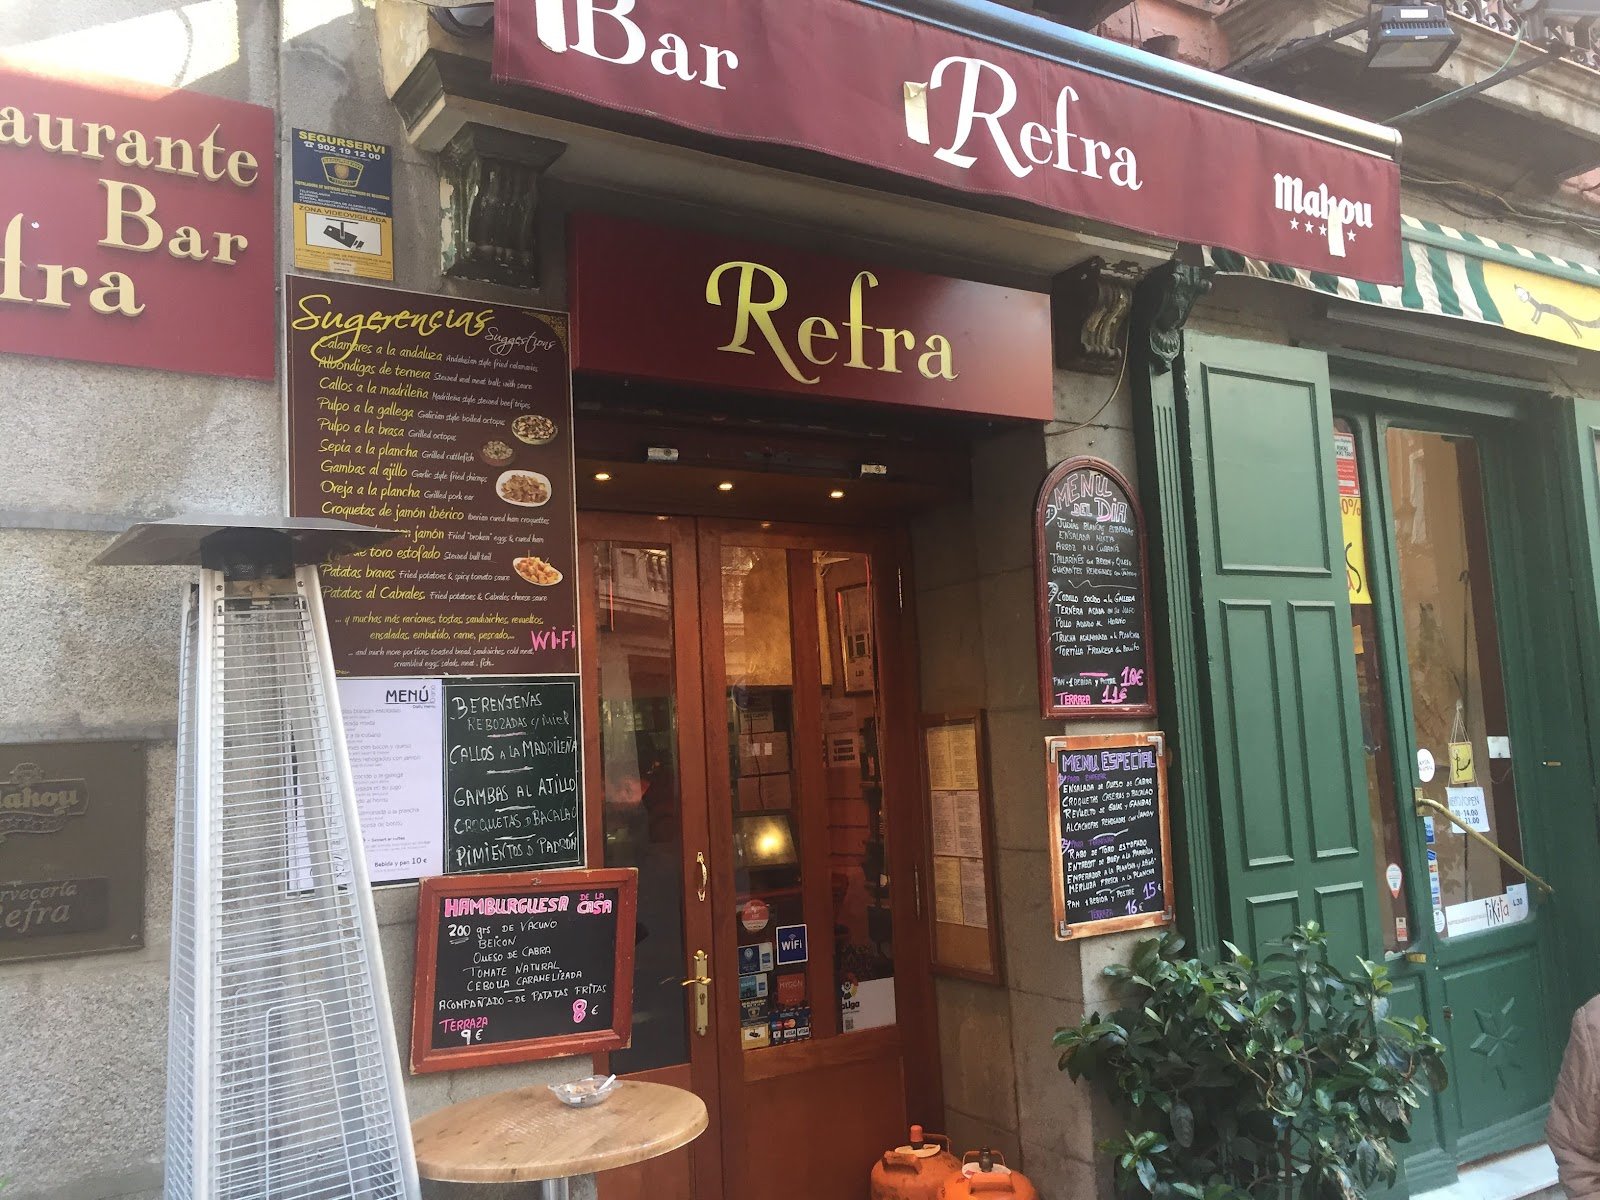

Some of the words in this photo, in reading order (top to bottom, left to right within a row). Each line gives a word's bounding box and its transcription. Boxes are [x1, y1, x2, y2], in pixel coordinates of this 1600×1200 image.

[569, 0, 739, 91] Bar
[930, 55, 1143, 191] Refra
[0, 106, 259, 187] aurante
[299, 130, 386, 154] SEGURSERVI
[317, 143, 336, 153] 902
[339, 147, 351, 155] 19
[354, 150, 366, 158] 12
[368, 152, 381, 161] 00
[97, 178, 249, 265] Bar
[299, 205, 325, 214] ZONA
[325, 209, 387, 224] VIDEOVIGILADA
[292, 294, 494, 364] Sugerencias
[706, 261, 960, 384] Refra
[319, 336, 373, 354] Calamares
[376, 346, 382, 354] a
[386, 341, 396, 356] la
[400, 345, 442, 362] andaluza
[484, 326, 556, 356] Suggestions
[378, 361, 392, 375] de
[395, 365, 431, 380] ternera
[320, 376, 353, 393] Callos
[356, 384, 364, 394] a
[367, 380, 376, 394] la
[380, 382, 429, 400] madrileña
[316, 396, 350, 416] Pulpo
[354, 404, 360, 413] a
[364, 400, 374, 414] la
[376, 402, 414, 421] gallega
[316, 417, 350, 436] Pulpo
[354, 424, 362, 434] a
[364, 420, 374, 434] la
[378, 421, 405, 437] brasa
[408, 429, 432, 439] Grilled
[318, 439, 352, 456] Sepia
[354, 446, 362, 454] a
[366, 440, 376, 454] la
[378, 441, 419, 460] plancha
[422, 450, 445, 460] Grilled
[320, 460, 366, 476] Gambas
[369, 460, 380, 476] al
[382, 462, 408, 480] ajillo
[320, 480, 354, 498] Oreja
[368, 481, 378, 496] la
[380, 482, 420, 500] plancha
[424, 490, 447, 499] Grilled
[1054, 473, 1112, 510] MENU
[321, 501, 376, 520] Croquetas
[378, 502, 392, 516] de
[394, 504, 426, 522] jamón
[428, 506, 465, 520] ibérico
[1071, 502, 1092, 517] DEL
[412, 525, 444, 543] jamón
[448, 531, 466, 540] Fried
[370, 547, 393, 558] toro
[396, 544, 441, 562] estofado
[320, 564, 362, 578] Patatas
[365, 564, 396, 580] bravas
[398, 570, 418, 580] Fried
[320, 586, 362, 600] Patatas
[366, 584, 377, 599] al
[430, 591, 448, 600] Fried
[352, 611, 382, 624] muchas
[384, 614, 400, 624] más
[386, 685, 429, 702] MENÚ
[1055, 692, 1090, 705] TERRAZA
[451, 691, 543, 719] BERENJENAS
[468, 716, 528, 731] REBOZADAS
[450, 745, 495, 764] CALLOS
[500, 750, 506, 760] A
[508, 745, 520, 758] LA
[522, 736, 577, 758] MADRILEÑA
[1062, 754, 1100, 772] MENU
[1100, 749, 1156, 772] ESPECIAL
[454, 784, 508, 806] GAMBAS
[516, 784, 532, 798] AL
[538, 774, 576, 796] AJILLO
[1063, 784, 1094, 794] ENSALADA
[1062, 796, 1098, 808] CROQUETAS
[454, 814, 522, 834] CROQUETAS
[532, 806, 577, 826] BACALAO
[456, 842, 522, 866] PIMIENTOS
[1118, 839, 1148, 852] ESTOFADO
[1142, 881, 1156, 900] 15
[444, 896, 570, 918] HAMBURGUESA
[576, 900, 612, 914] CASA
[1125, 898, 1138, 914] 16
[0, 900, 70, 934] efra
[448, 924, 471, 937] 200
[476, 926, 490, 940] grs
[520, 916, 558, 932] VACUNO
[478, 935, 517, 950] BEICON
[507, 951, 518, 960] DE
[522, 946, 552, 956] CABRA
[462, 966, 507, 978] TOMATE
[515, 961, 560, 974] NATURAL
[466, 980, 510, 992] CEBOLLA
[516, 970, 582, 986] CARAMELIZADA
[514, 996, 526, 1004] DE
[532, 988, 568, 1002] PATATAS
[574, 984, 607, 995] FRITAS
[572, 998, 588, 1024] 8
[591, 1004, 598, 1016] €
[438, 1016, 488, 1034] TERRAZA
[460, 1030, 472, 1046] 9
[475, 1030, 484, 1041] €
